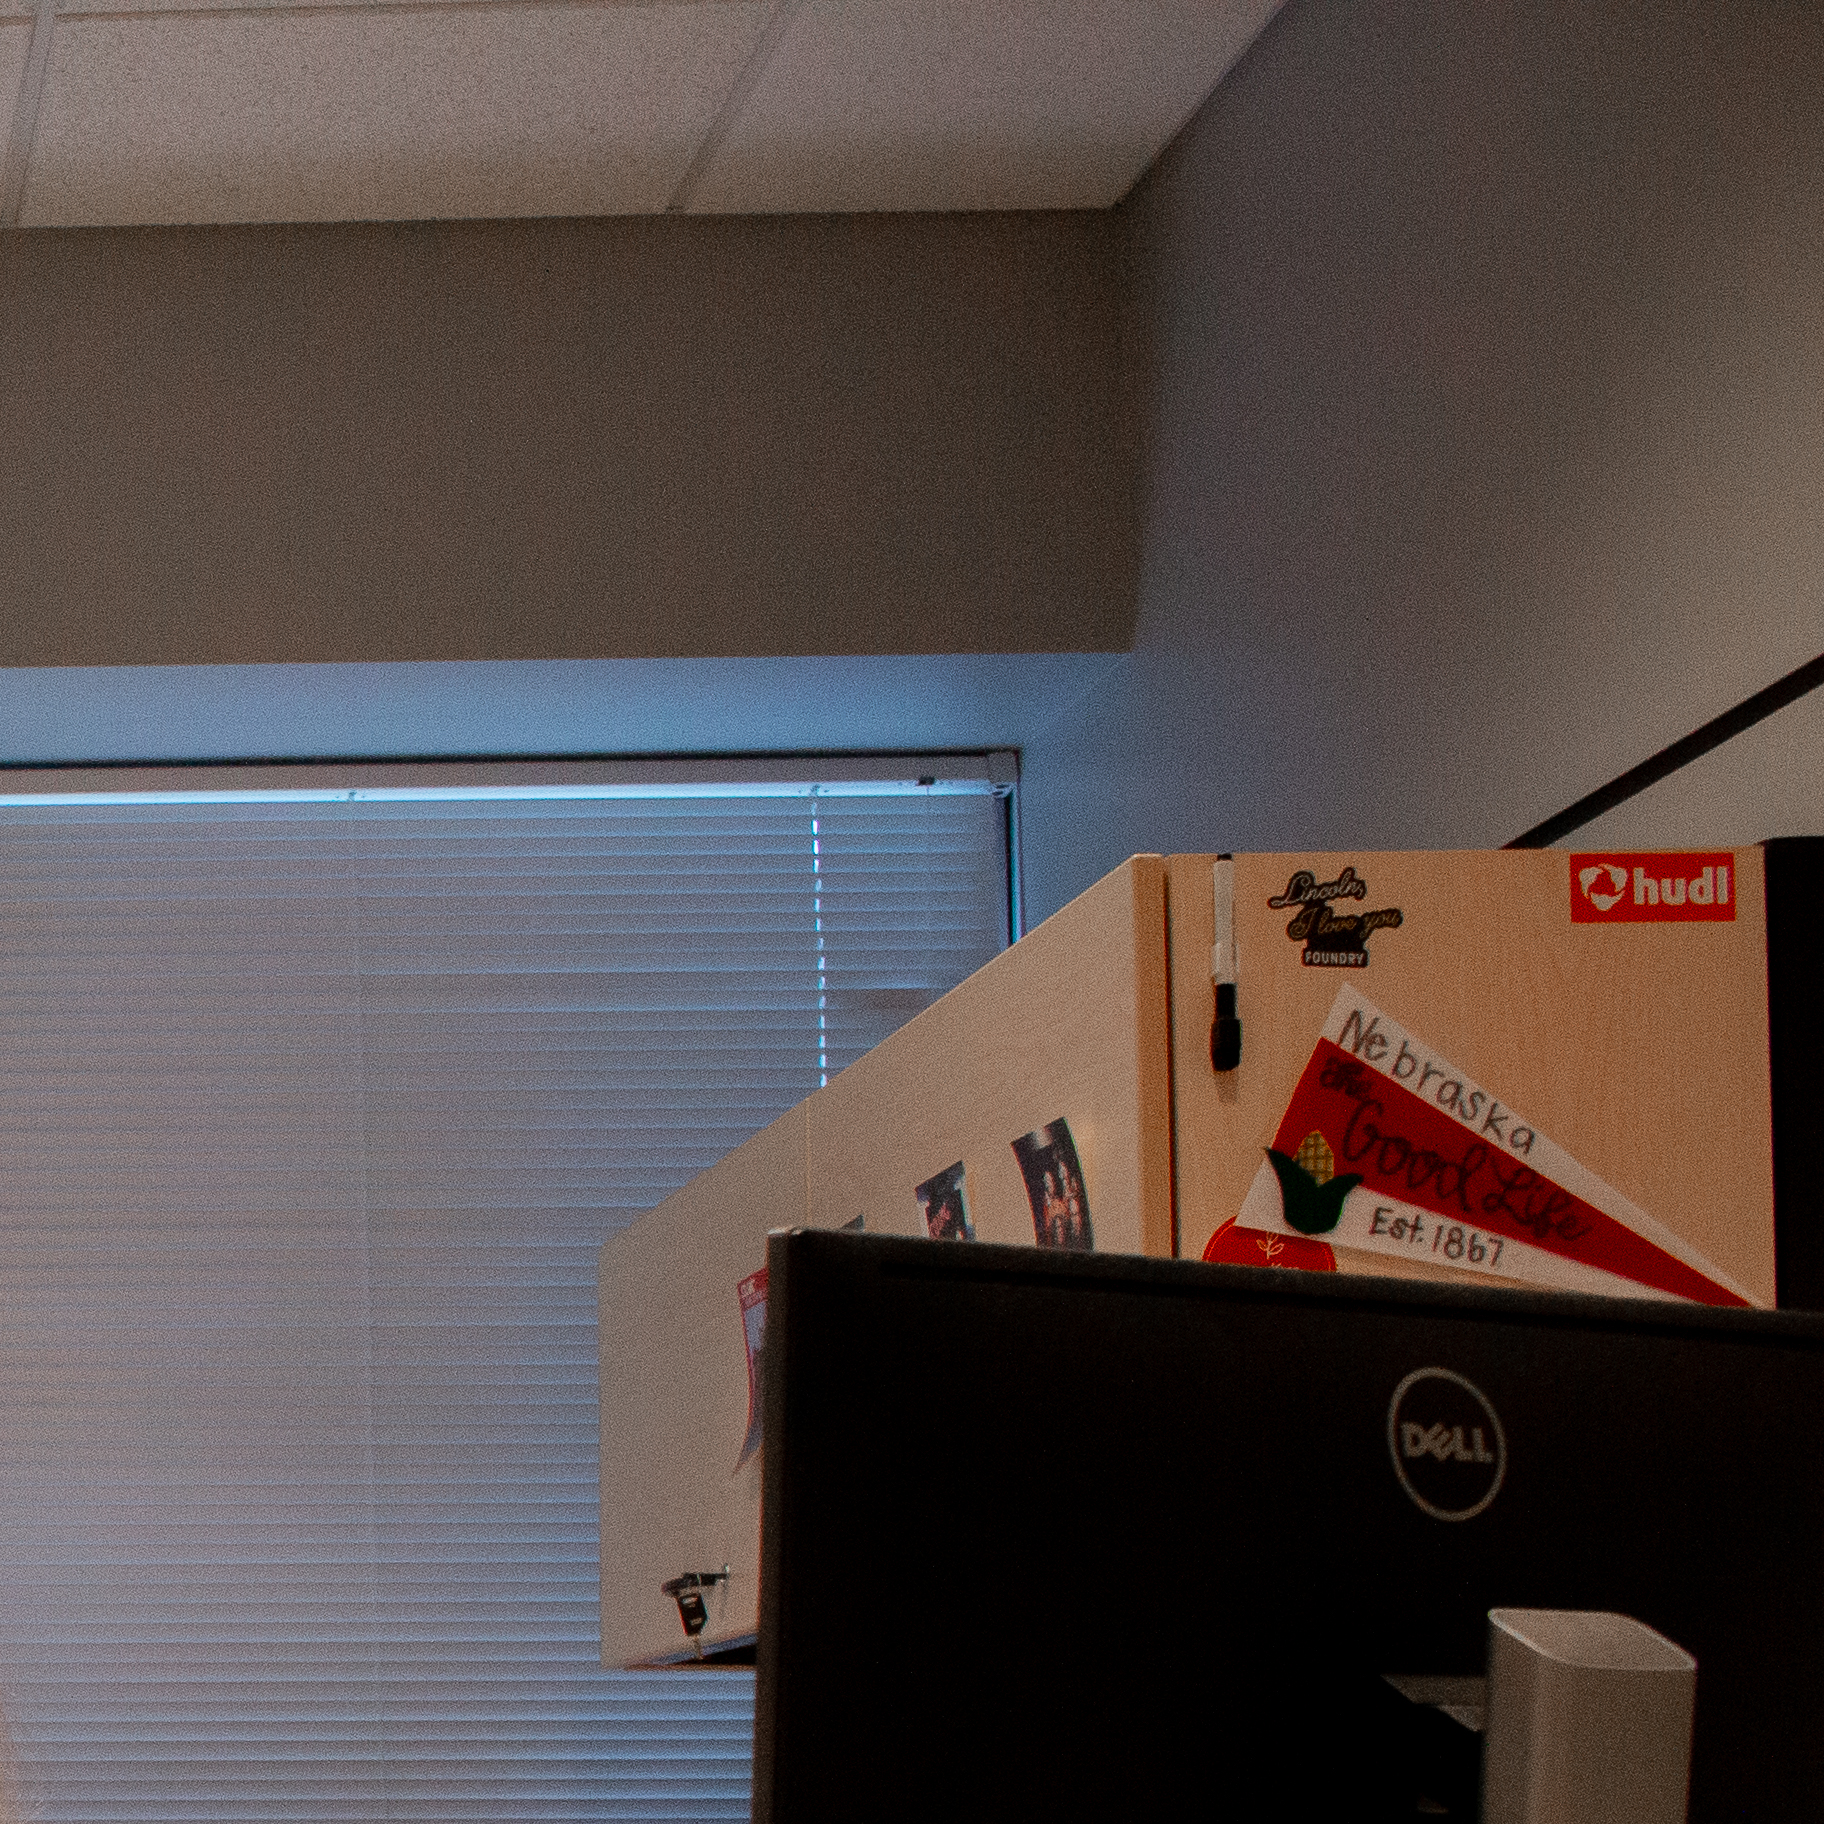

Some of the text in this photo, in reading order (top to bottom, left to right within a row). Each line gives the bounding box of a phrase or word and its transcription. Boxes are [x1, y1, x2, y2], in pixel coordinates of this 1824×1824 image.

[1633, 866, 1729, 905] hudl
[1358, 909, 1400, 940] you
[1305, 952, 1365, 965] FOUNDRY
[1336, 1008, 1536, 1157] Nebraska
[1343, 1099, 1594, 1240] Good Life
[1368, 1206, 1506, 1267] Est. 1867
[1402, 1421, 1494, 1464] DELL
